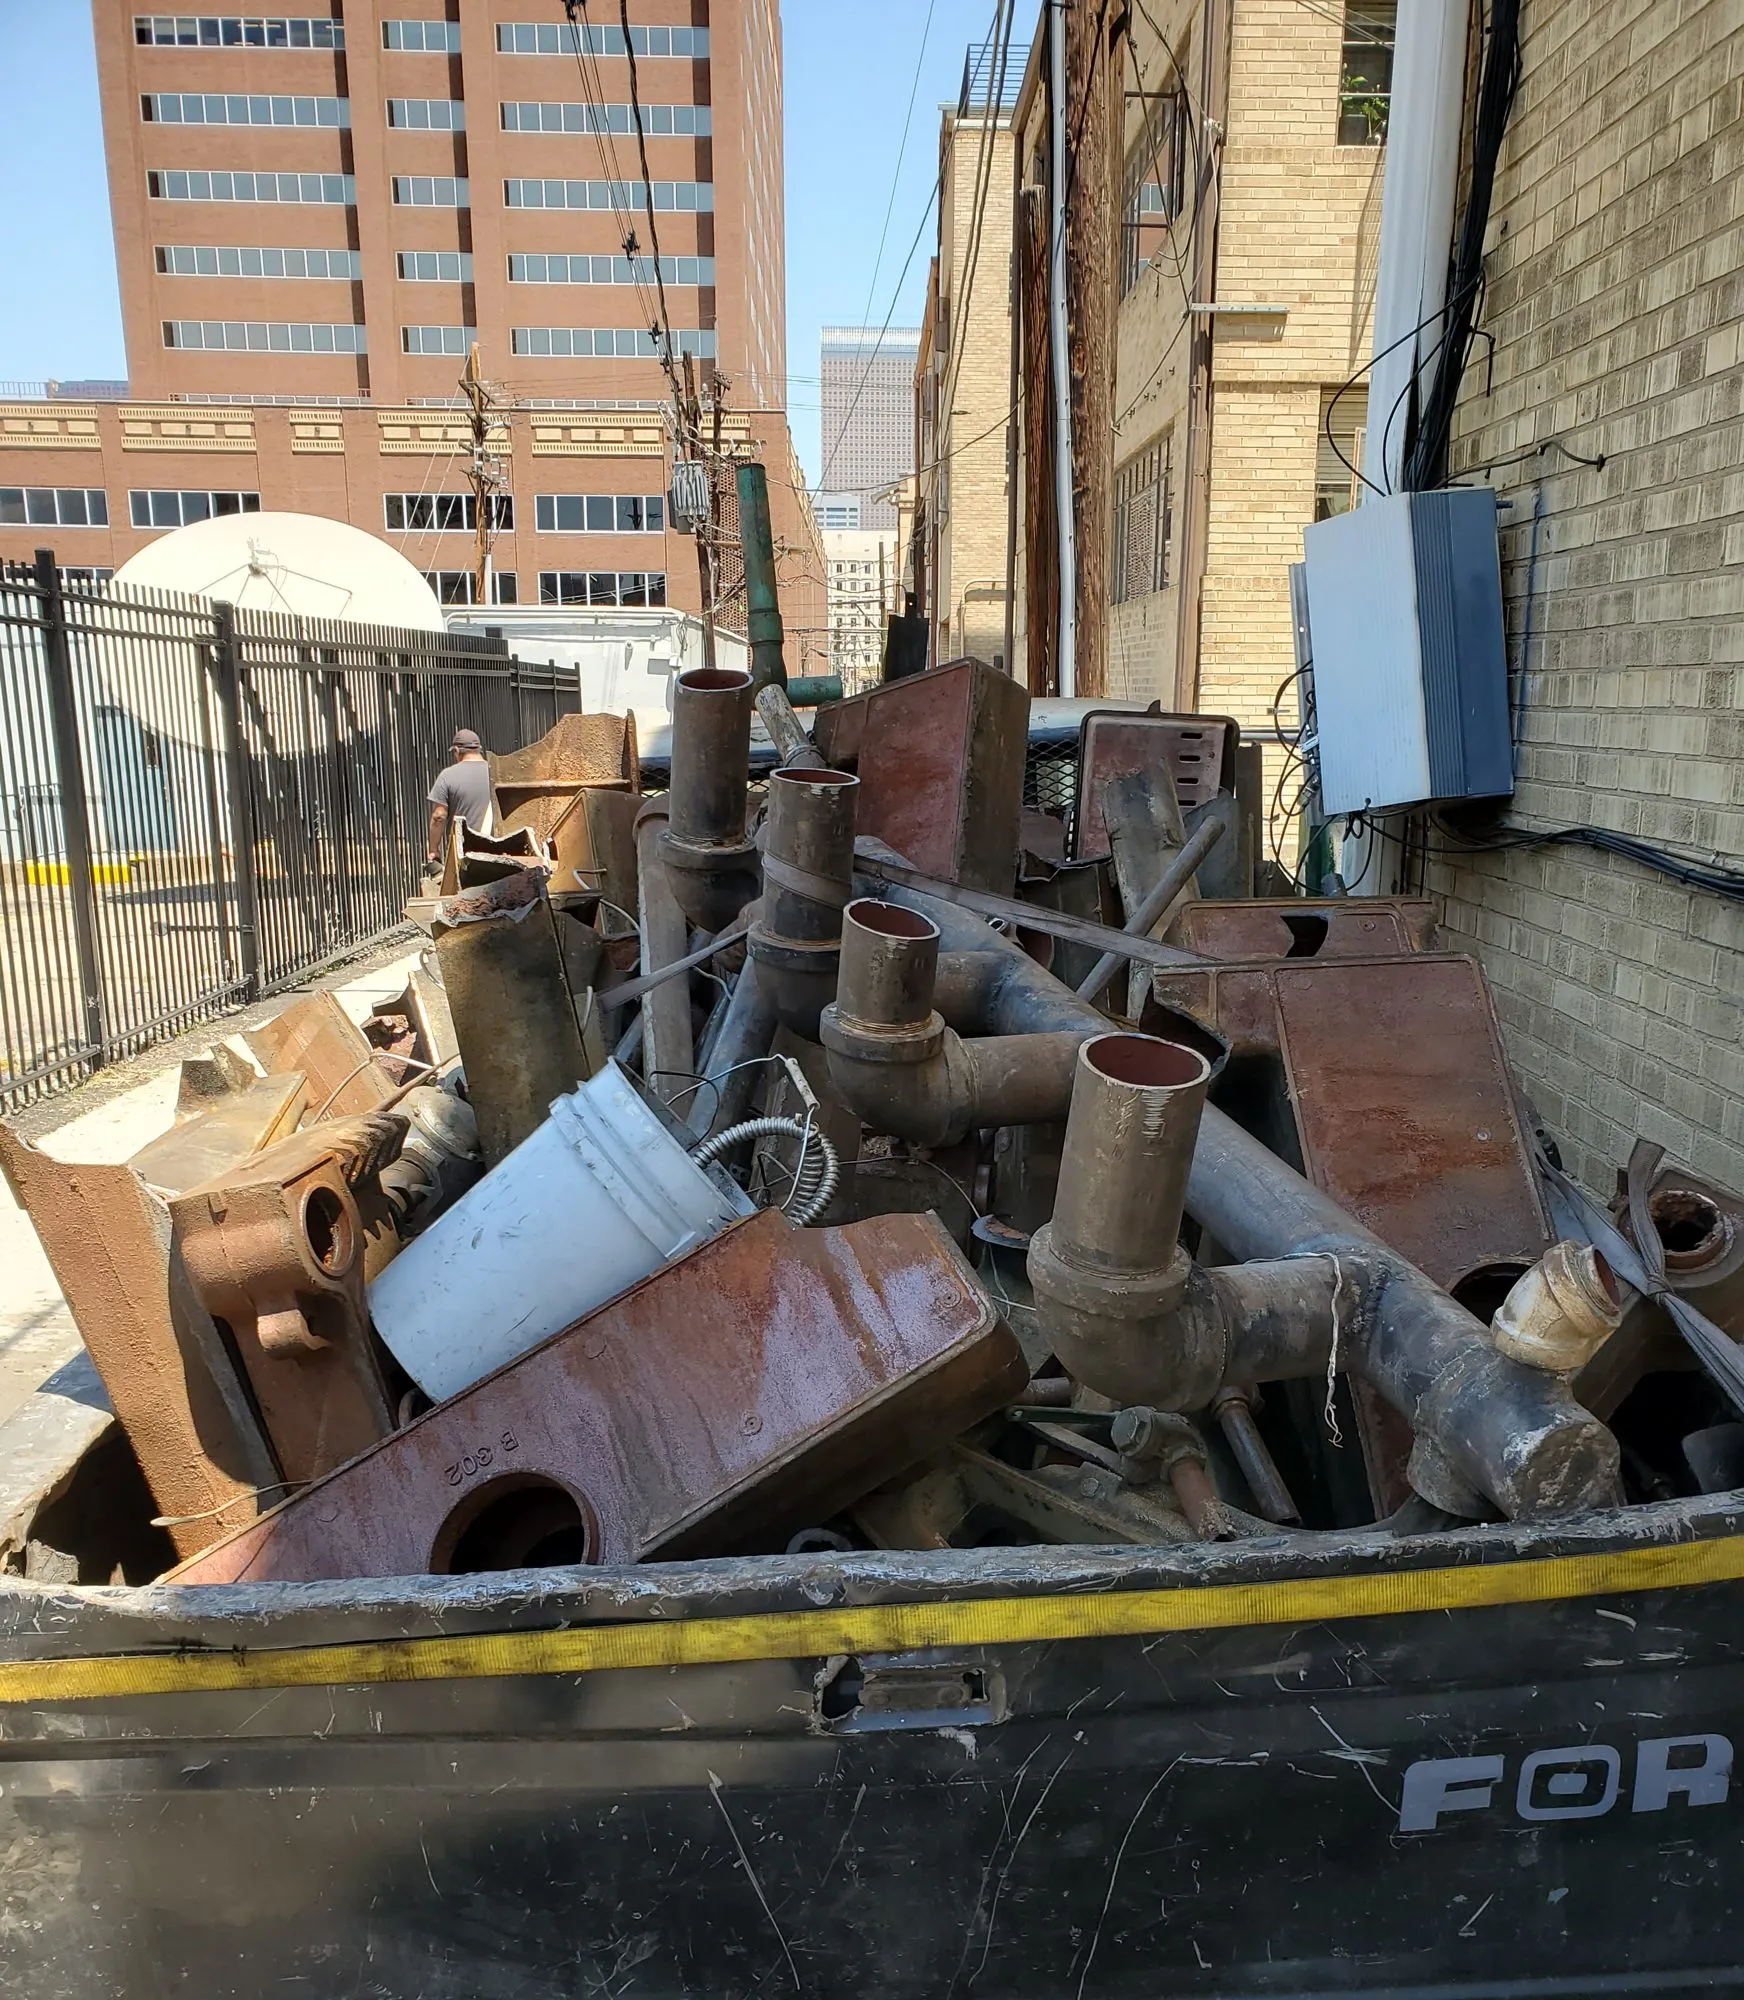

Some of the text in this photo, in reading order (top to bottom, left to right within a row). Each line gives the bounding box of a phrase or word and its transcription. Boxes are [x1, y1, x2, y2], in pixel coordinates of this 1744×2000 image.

[444, 1430, 519, 1486] B 302
[1400, 1733, 1734, 1831] FOR
